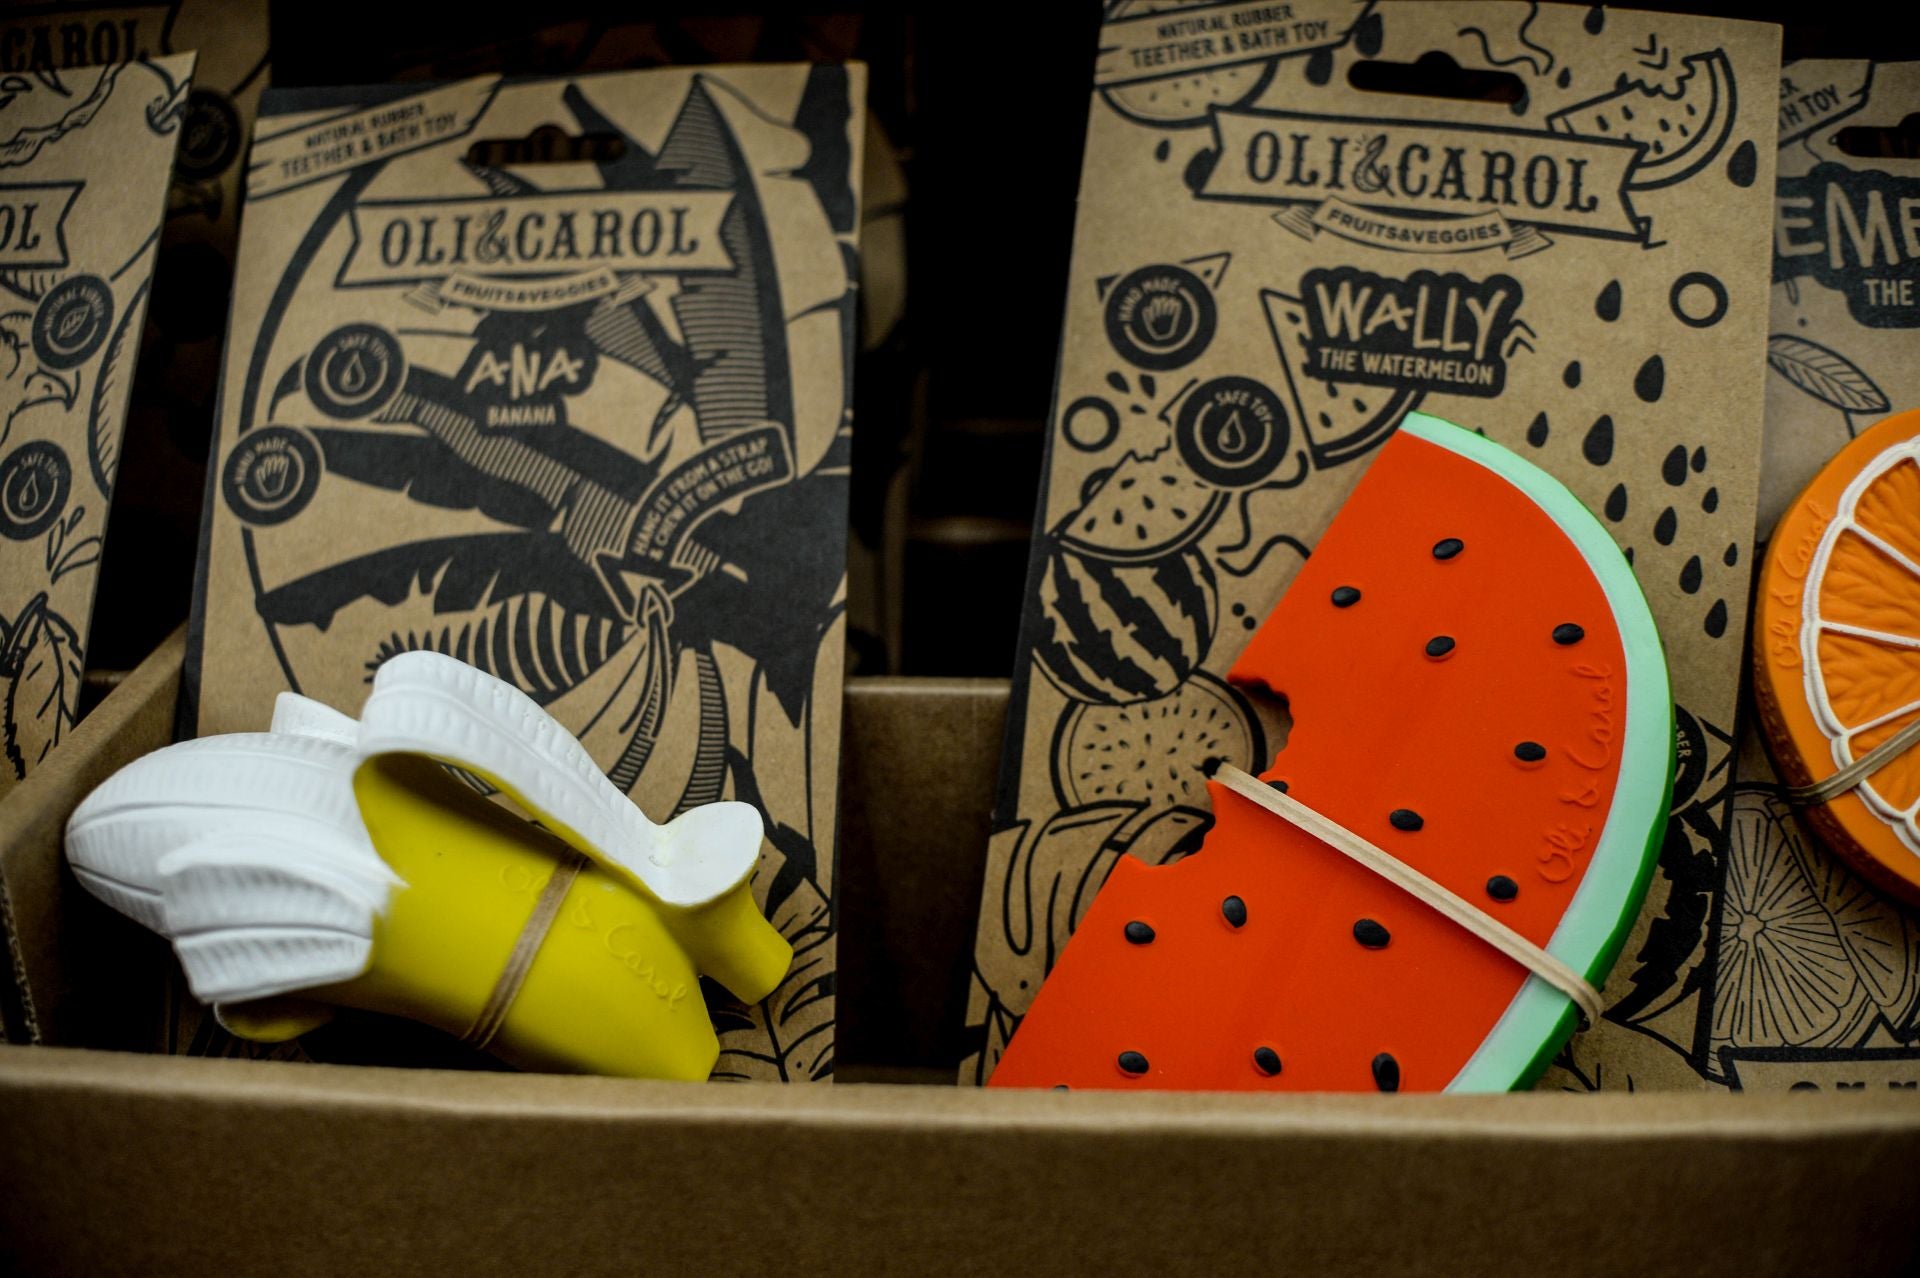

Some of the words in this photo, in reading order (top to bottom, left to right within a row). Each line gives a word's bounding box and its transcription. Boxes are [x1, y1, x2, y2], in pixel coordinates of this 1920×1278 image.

[1130, 38, 1217, 68] TEETHER
[1222, 35, 1234, 53] &
[1238, 26, 1289, 49] BATH
[1291, 20, 1329, 41] TOY
[1157, 16, 1230, 39] NATURAL
[1231, 5, 1294, 28] RUBBER
[1799, 84, 1840, 116] TOY
[280, 143, 352, 177] TEETHER
[361, 138, 373, 153] &
[378, 126, 421, 148] BATH
[426, 112, 458, 133] TOY
[305, 119, 367, 149] NATURAL
[371, 102, 426, 128] RUBBER
[1246, 129, 1599, 213] OLI&CAROL
[380, 205, 701, 268] OLI&CAROL
[1326, 209, 1503, 245] FRUITS&VEGGIES
[451, 275, 610, 303] FRUITS&VEGGIES
[1118, 286, 1143, 322] HAND
[1142, 276, 1180, 294] MADE
[1863, 278, 1915, 306] THE
[1314, 279, 1509, 361] WALLY
[464, 341, 586, 401] ANA
[1318, 347, 1358, 372] THE
[1361, 351, 1496, 386] WATERMELON
[486, 403, 557, 428] BANANA
[1214, 388, 1251, 407] SAFE
[1249, 397, 1274, 423] TOY
[20, 451, 45, 471] SAFE
[234, 451, 256, 486] HAND
[255, 436, 289, 451] MADE
[631, 509, 662, 556] HANG
[654, 492, 673, 514] IT
[667, 461, 709, 500] FROM
[706, 456, 721, 474] A
[716, 436, 769, 470] STRAP
[680, 491, 699, 513] IT
[695, 478, 720, 502] ON
[714, 463, 747, 490] THE
